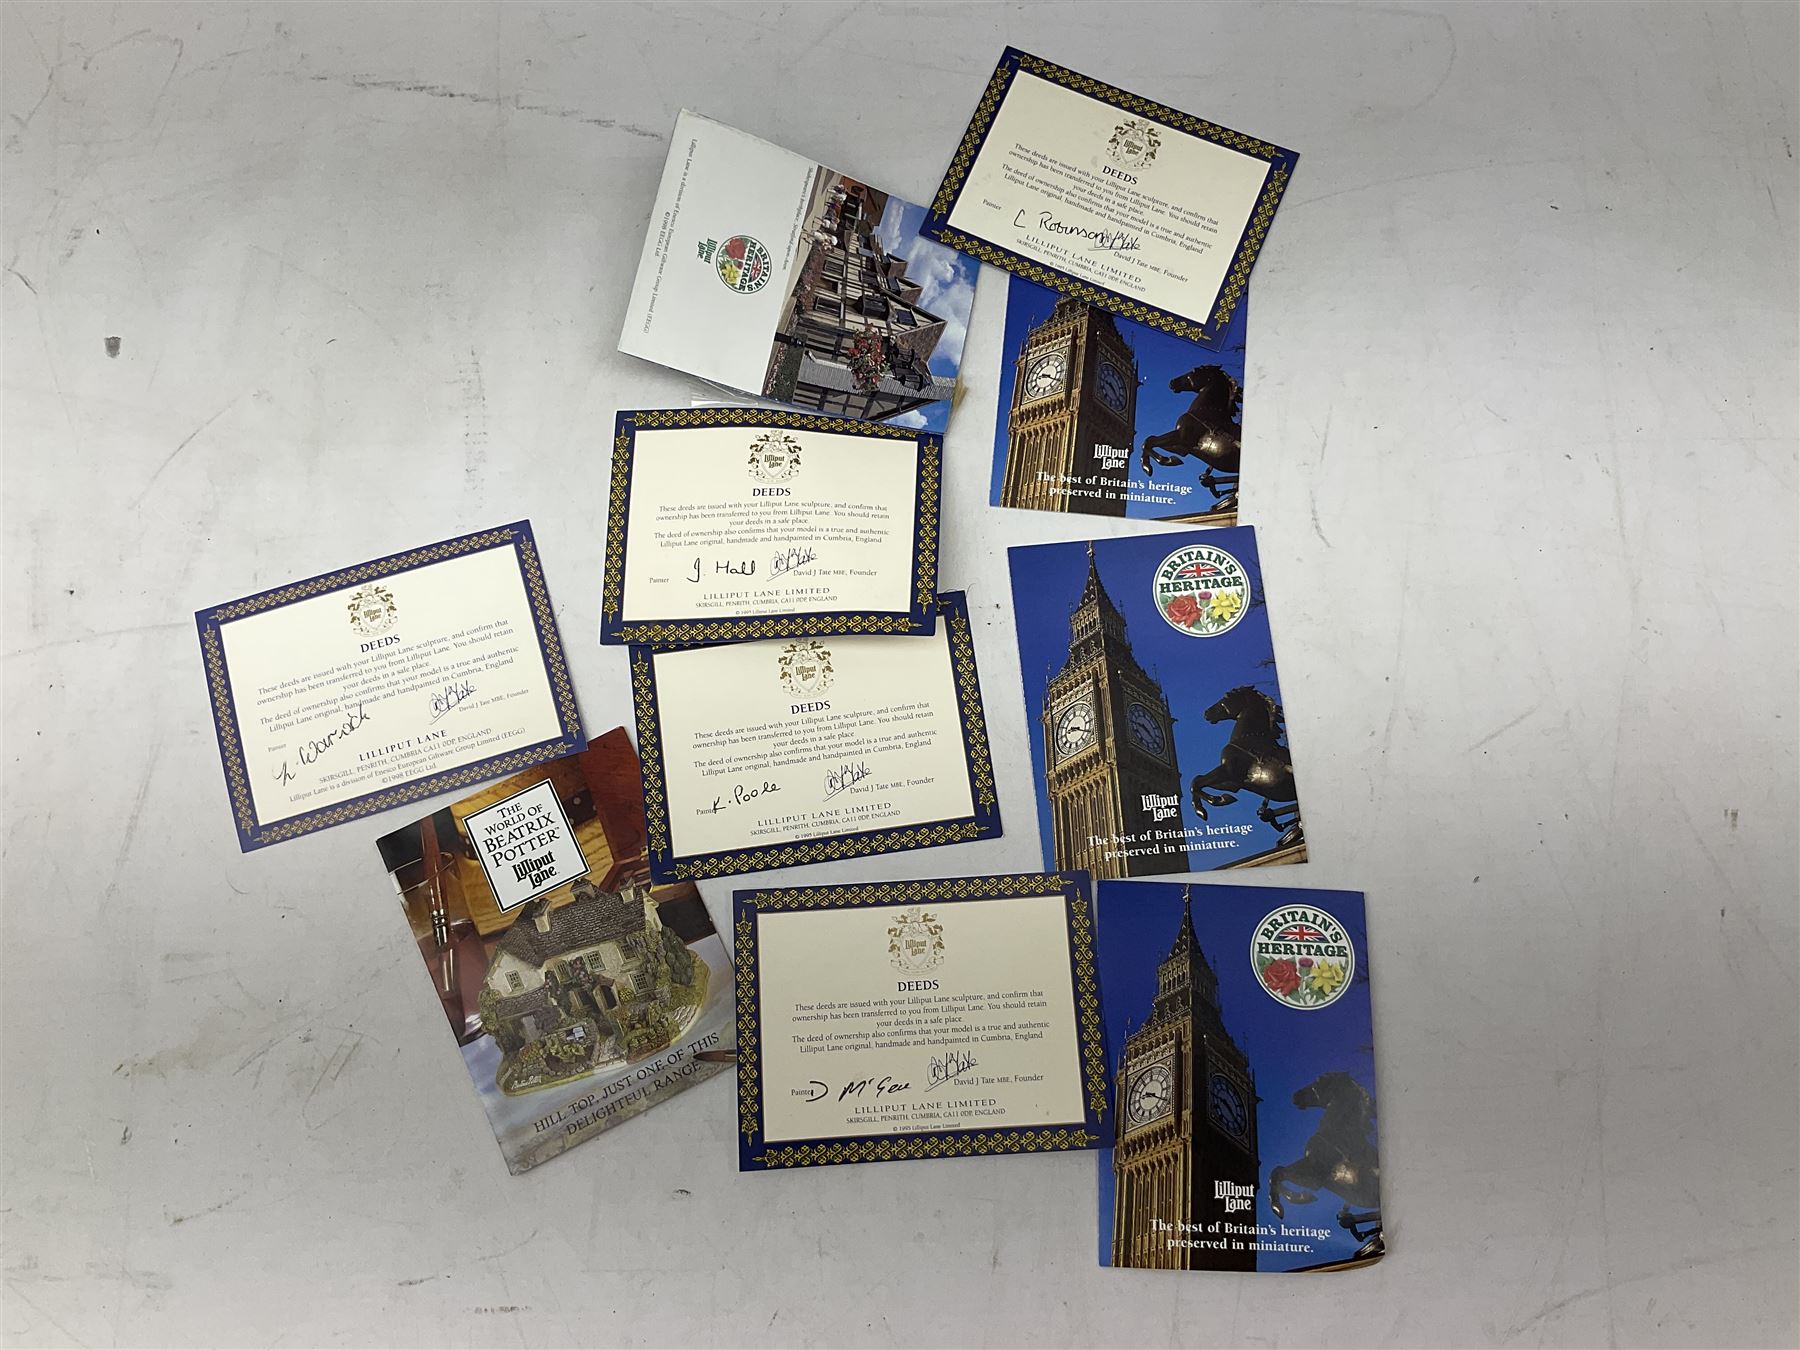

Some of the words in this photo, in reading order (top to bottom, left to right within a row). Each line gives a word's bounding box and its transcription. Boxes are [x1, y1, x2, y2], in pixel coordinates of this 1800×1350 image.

[1102, 165, 1138, 185] DEEDS
[1004, 172, 1025, 186] Lilliput
[1025, 181, 1040, 192] Lane
[1064, 197, 1095, 214] handmade
[1094, 211, 1107, 219] and
[1106, 213, 1144, 233] handpainted
[696, 241, 708, 259] Lane
[703, 238, 718, 264] Lilliput
[1026, 234, 1068, 255] LILLIPUT
[1071, 252, 1097, 267] LANE
[1100, 264, 1142, 283] LIMITED
[738, 240, 757, 292] HERITAGE
[746, 245, 769, 291] BRITAIN'S
[1093, 443, 1130, 462] Lilliput
[1101, 456, 1126, 471] Lane
[752, 487, 791, 497] DEEDS
[1035, 471, 1056, 482] The
[1058, 473, 1083, 485] best
[1085, 475, 1098, 486] of
[1100, 476, 1145, 490] Britain's
[1148, 480, 1193, 495] heritage
[1049, 485, 1102, 499] preserved
[1105, 489, 1117, 500] in
[1119, 490, 1177, 505] miniature.
[729, 520, 744, 528] your
[715, 560, 756, 576] Hall
[1160, 550, 1238, 582] BRITAIN'S
[703, 591, 749, 600] LILLIPUT
[754, 589, 780, 597] LANE
[785, 587, 830, 596] LIMITED
[1158, 575, 1244, 594] HERITAGE
[360, 634, 401, 653] DEEDS
[790, 700, 831, 715] DEEDS
[692, 739, 727, 749] ownership
[727, 737, 740, 745] has
[740, 735, 757, 743] been
[757, 729, 793, 740] transferred
[802, 727, 816, 736] you
[833, 721, 857, 730] Lilliput
[891, 712, 914, 722] should
[915, 711, 934, 719] retain
[359, 739, 411, 762] LILLIPUT
[417, 729, 447, 744] LANE
[733, 781, 781, 805] Poole
[1140, 791, 1180, 811] Lilliput
[484, 813, 526, 836] WORLD
[527, 803, 543, 817] OF
[496, 801, 523, 819] THE
[757, 813, 807, 827] LILLIPUT
[811, 809, 841, 819] LANE
[844, 802, 891, 815] LIMITED
[1151, 803, 1179, 823] Lane
[482, 811, 556, 854] BEATRIX
[1086, 834, 1110, 847] The
[1111, 832, 1138, 847] best
[1138, 830, 1153, 843] of
[1154, 825, 1203, 841] Britain's
[1205, 821, 1254, 839] heritage
[1104, 843, 1161, 861] preserved
[1163, 842, 1176, 854] in
[1178, 836, 1241, 853] miniature.
[511, 850, 556, 882] Lilliput
[526, 865, 557, 890] Lane
[1261, 910, 1343, 944] BRITAIN'S
[1256, 942, 1349, 958] HERITAGE
[897, 979, 939, 992] DEEDS
[795, 1003, 815, 1011] These
[816, 1001, 836, 1010] deeds
[849, 999, 871, 1008] issued
[872, 998, 888, 1006] with
[889, 999, 906, 1008] your
[907, 996, 932, 1006] Lilliput
[933, 995, 950, 1003] Lane
[987, 991, 1000, 1000] and
[1001, 990, 1029, 999] confirm
[1029, 989, 1044, 997] that
[533, 1110, 568, 1133] HILL
[601, 1075, 633, 1099] JUST
[636, 1061, 665, 1081] ONE
[666, 1049, 685, 1065] OF
[687, 1031, 720, 1054] THIS
[953, 1076, 974, 1086] David
[975, 1077, 979, 1086] J
[980, 1076, 995, 1084] Tate
[1014, 1073, 1044, 1083] Founder
[565, 1087, 653, 1135] DELIGHTFUL
[653, 1061, 702, 1091] RANGE
[855, 1104, 906, 1114] LILLIPUT
[912, 1102, 942, 1111] LANE
[947, 1098, 996, 1109] LIMITED
[1214, 1180, 1256, 1199] Lilliput
[1224, 1194, 1253, 1213] Lane
[1149, 1219, 1175, 1232] The
[1177, 1219, 1204, 1234] best
[1206, 1221, 1221, 1233] of
[1224, 1222, 1277, 1236] Britain's
[1280, 1224, 1332, 1240] heritage
[1166, 1237, 1228, 1250] preserved
[1231, 1238, 1245, 1250] in
[1248, 1239, 1315, 1253] miniature.
